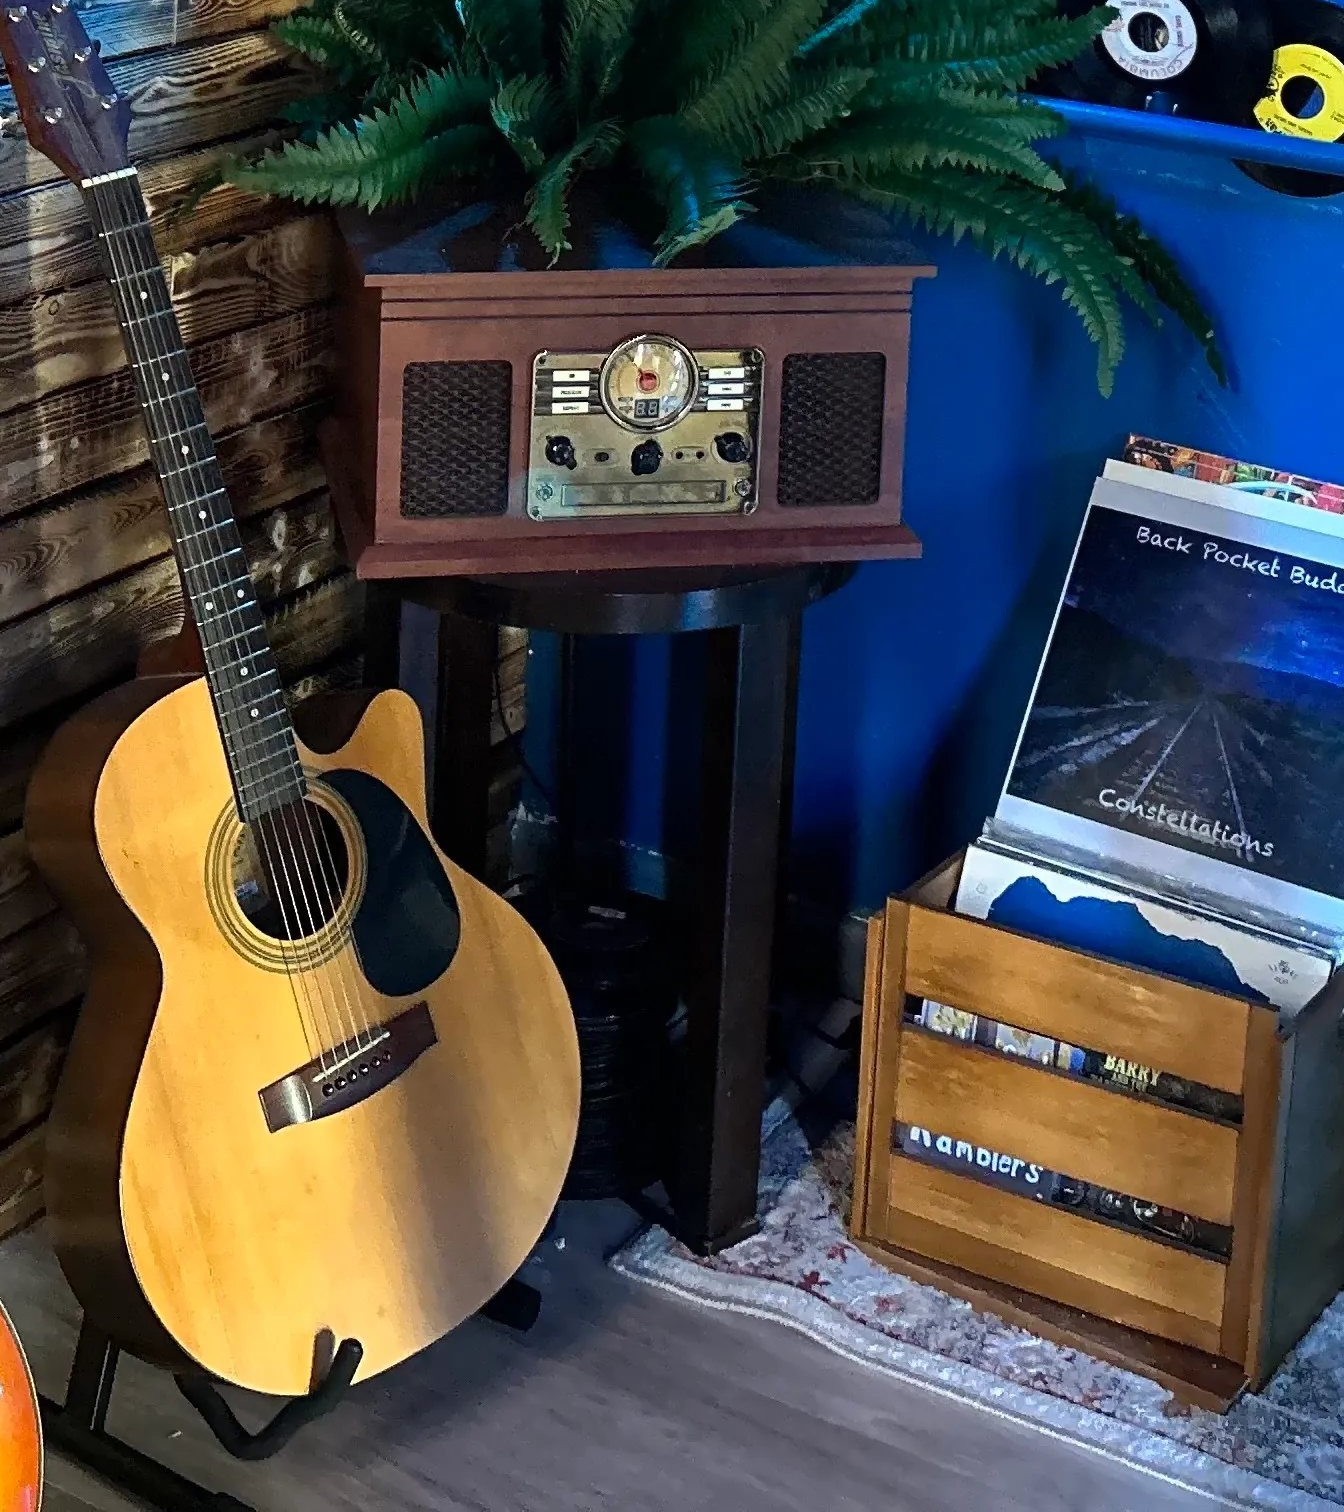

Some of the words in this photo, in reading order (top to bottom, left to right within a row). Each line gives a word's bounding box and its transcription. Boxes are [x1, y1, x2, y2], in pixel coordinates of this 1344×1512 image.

[1136, 526, 1193, 554] Back
[1203, 541, 1280, 578] Pocket
[1098, 788, 1275, 858] Constellations
